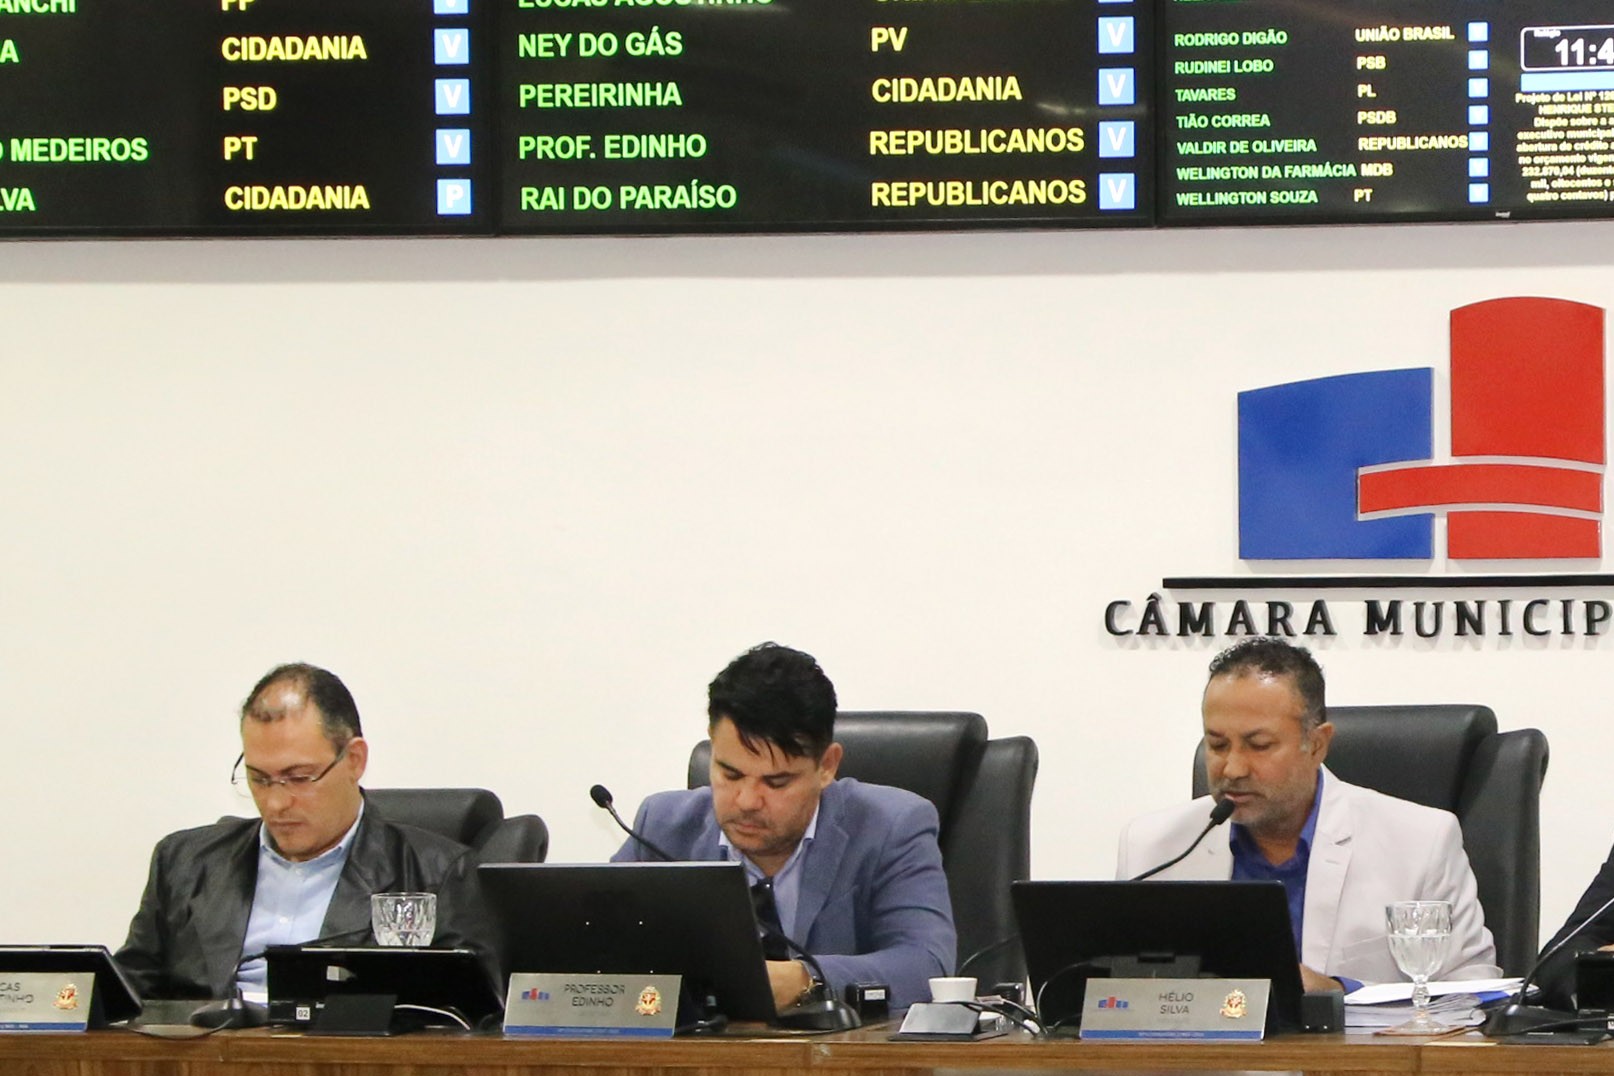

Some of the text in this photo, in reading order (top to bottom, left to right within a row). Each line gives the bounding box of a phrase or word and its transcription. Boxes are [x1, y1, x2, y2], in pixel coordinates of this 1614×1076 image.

[519, 26, 682, 57] NEY DO GÁS
[872, 27, 907, 51] PV
[1106, 22, 1126, 46] V
[1175, 29, 1287, 46] RODRIGO DIGÃO
[1355, 26, 1454, 41] UNIÃO BRASIL
[0, 40, 19, 63] A
[222, 36, 367, 60] CIDADANIA
[442, 33, 462, 58] V
[1175, 59, 1273, 74] RUDINEI LOBO
[1357, 56, 1386, 69] PSB
[443, 84, 462, 108] V
[520, 82, 682, 107] PEREIRINHA
[872, 76, 1022, 102] CIDADANIA
[1107, 74, 1126, 98] V
[1175, 88, 1236, 101] TAVARES
[1358, 84, 1376, 97] PL
[224, 87, 276, 110] PSD
[1176, 114, 1270, 128] TIÃO CORREA
[1358, 111, 1396, 124] PSDB
[11, 138, 148, 161] MEDEIROS
[224, 137, 257, 160] PT
[444, 134, 463, 158] V
[520, 134, 706, 159] PROF. EDINHO
[870, 128, 1084, 154] REPUBLICANOS
[1107, 127, 1126, 150] V
[1177, 139, 1317, 154] VALDIR DE OLIVEIRA
[1359, 135, 1468, 150] REPUBLICANOS
[1177, 162, 1356, 180] WELINGTON DA FARMÁCIA
[1361, 163, 1393, 176] MDB
[225, 186, 370, 210] CIDADANIA
[446, 184, 464, 208] P
[522, 179, 736, 210] RAI DO PARAÍSO
[872, 180, 1086, 206] REPUBLICANOS
[1108, 179, 1126, 203] V
[1177, 190, 1318, 205] WELLINGTON SOUZA
[1354, 189, 1372, 202] PT
[1104, 592, 1337, 637] CÂMARA
[564, 984, 625, 994] PROFESSOR
[1159, 991, 1193, 1001] HÉLIO
[572, 997, 614, 1007] EDINHO
[1160, 1004, 1189, 1014] SILVA
